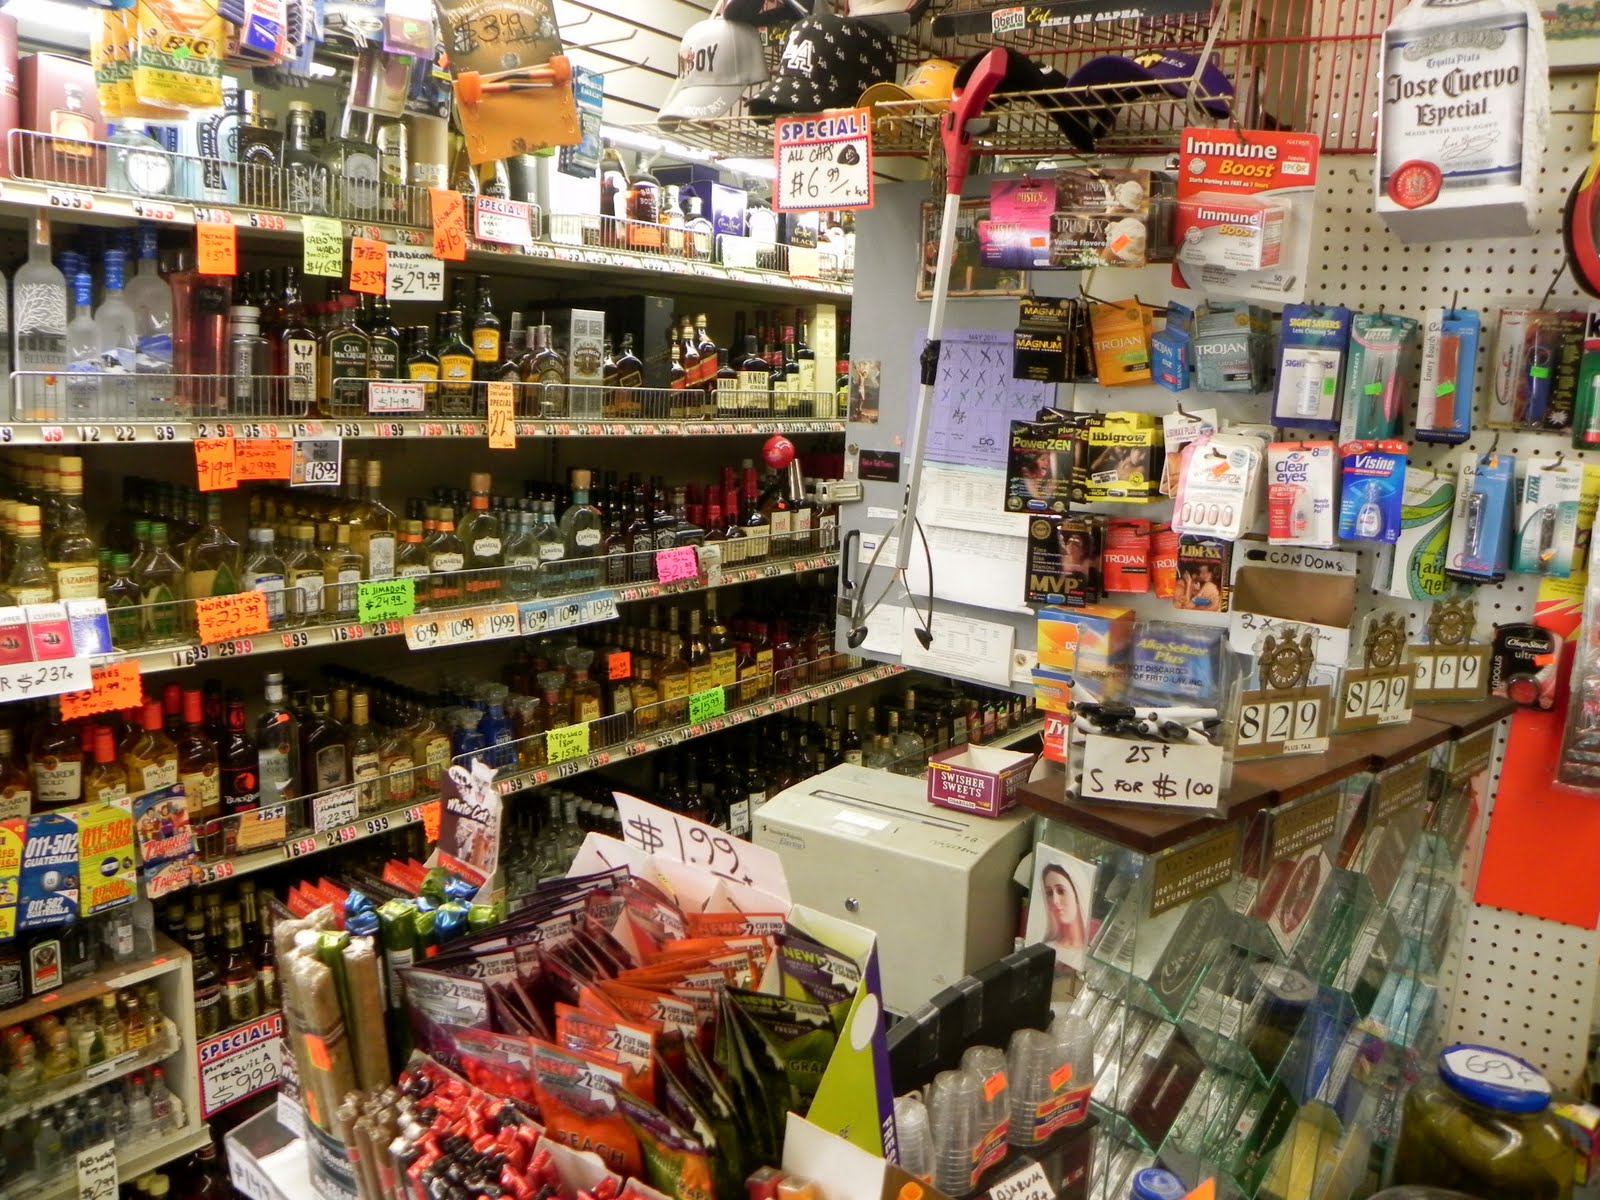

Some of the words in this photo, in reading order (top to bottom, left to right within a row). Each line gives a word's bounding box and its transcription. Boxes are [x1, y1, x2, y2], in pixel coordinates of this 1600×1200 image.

[993, 13, 1023, 29] Oberto
[1027, 7, 1051, 23] Eat
[1073, 14, 1093, 24] AN
[1426, 56, 1456, 69] Tequila
[1386, 73, 1438, 104] Jose
[1442, 65, 1520, 97] Cuervo
[1414, 98, 1489, 127] Especial
[782, 115, 867, 141] SPECIAL!
[788, 150, 804, 163] ALL
[809, 144, 834, 163] CAPS
[1187, 137, 1278, 160] Immune
[1219, 159, 1275, 178] Boost
[479, 199, 527, 216] SPECIAL!
[250, 213, 285, 230] 5999
[1197, 208, 1258, 225] Immune
[1218, 223, 1257, 237] Boost
[1024, 307, 1067, 317] MAGNUM
[1289, 318, 1312, 328] SIGHT
[1312, 320, 1340, 330] SAVERS
[1364, 328, 1392, 341] TRIM
[1016, 339, 1062, 350] MAGNUM
[1094, 336, 1143, 351] TROJAN
[1196, 342, 1247, 355] TROJAN
[1427, 336, 1436, 358] Boards
[1424, 360, 1433, 381] Emery
[718, 379, 735, 390] KNOB
[747, 372, 766, 386] KNOB
[336, 424, 360, 438] 799
[377, 424, 404, 438] 1899
[1058, 427, 1073, 435] Plus
[1092, 432, 1146, 444] libigrow
[1013, 437, 1071, 451] PowerZEN
[1275, 461, 1309, 473] Clear
[1354, 455, 1395, 471] Visine
[1277, 472, 1307, 485] eyes
[1104, 554, 1145, 564] TROJAN
[1270, 552, 1343, 571] CONDOMS
[372, 584, 407, 596] JIMADOR
[1030, 575, 1079, 593] MVP
[1423, 576, 1448, 592] net
[200, 595, 262, 613] HORNITOS
[219, 639, 252, 656] 2999
[282, 632, 308, 648] 999
[334, 625, 363, 640] 1699
[372, 621, 400, 636] 2899
[1507, 637, 1548, 650] ChapStick
[1154, 651, 1185, 665] Plus
[1276, 651, 1297, 662] NAT
[1129, 664, 1144, 672] NOT
[1271, 664, 1300, 685] SHERMAN
[1284, 743, 1299, 751] PLUS
[146, 765, 177, 780] BACARDI
[530, 771, 549, 785] 999
[558, 762, 579, 776] 1799
[588, 754, 610, 768] 2999
[941, 772, 985, 788] SWISHER
[1115, 781, 1143, 794] FOR
[943, 783, 982, 798] SWEETS
[83, 821, 131, 846] 011-503
[287, 839, 315, 857] 1699
[326, 827, 356, 844] 2499
[368, 817, 389, 834] 999
[1273, 840, 1302, 857] NATURAL
[1306, 824, 1334, 843] TOBACCO
[27, 833, 78, 858] 011-502
[24, 854, 78, 868] GUATEMALA
[1181, 858, 1232, 888] ADDITIVE-FREE
[1153, 888, 1191, 909] NATURAL
[1195, 869, 1231, 890] TOBACCO
[477, 963, 485, 977] 2
[487, 960, 498, 968] CUT
[488, 964, 516, 975] CIGARS
[658, 1005, 666, 1018] 2
[667, 1006, 679, 1015] CUT
[681, 1010, 694, 1019] END
[667, 1013, 695, 1025] CIGARS
[201, 1017, 282, 1061] SPECIAL!
[614, 1033, 622, 1047] 2
[623, 1036, 636, 1045] CUT
[637, 1039, 650, 1049] END
[623, 1043, 650, 1058] CIGARS
[559, 1130, 625, 1165] PEACH
